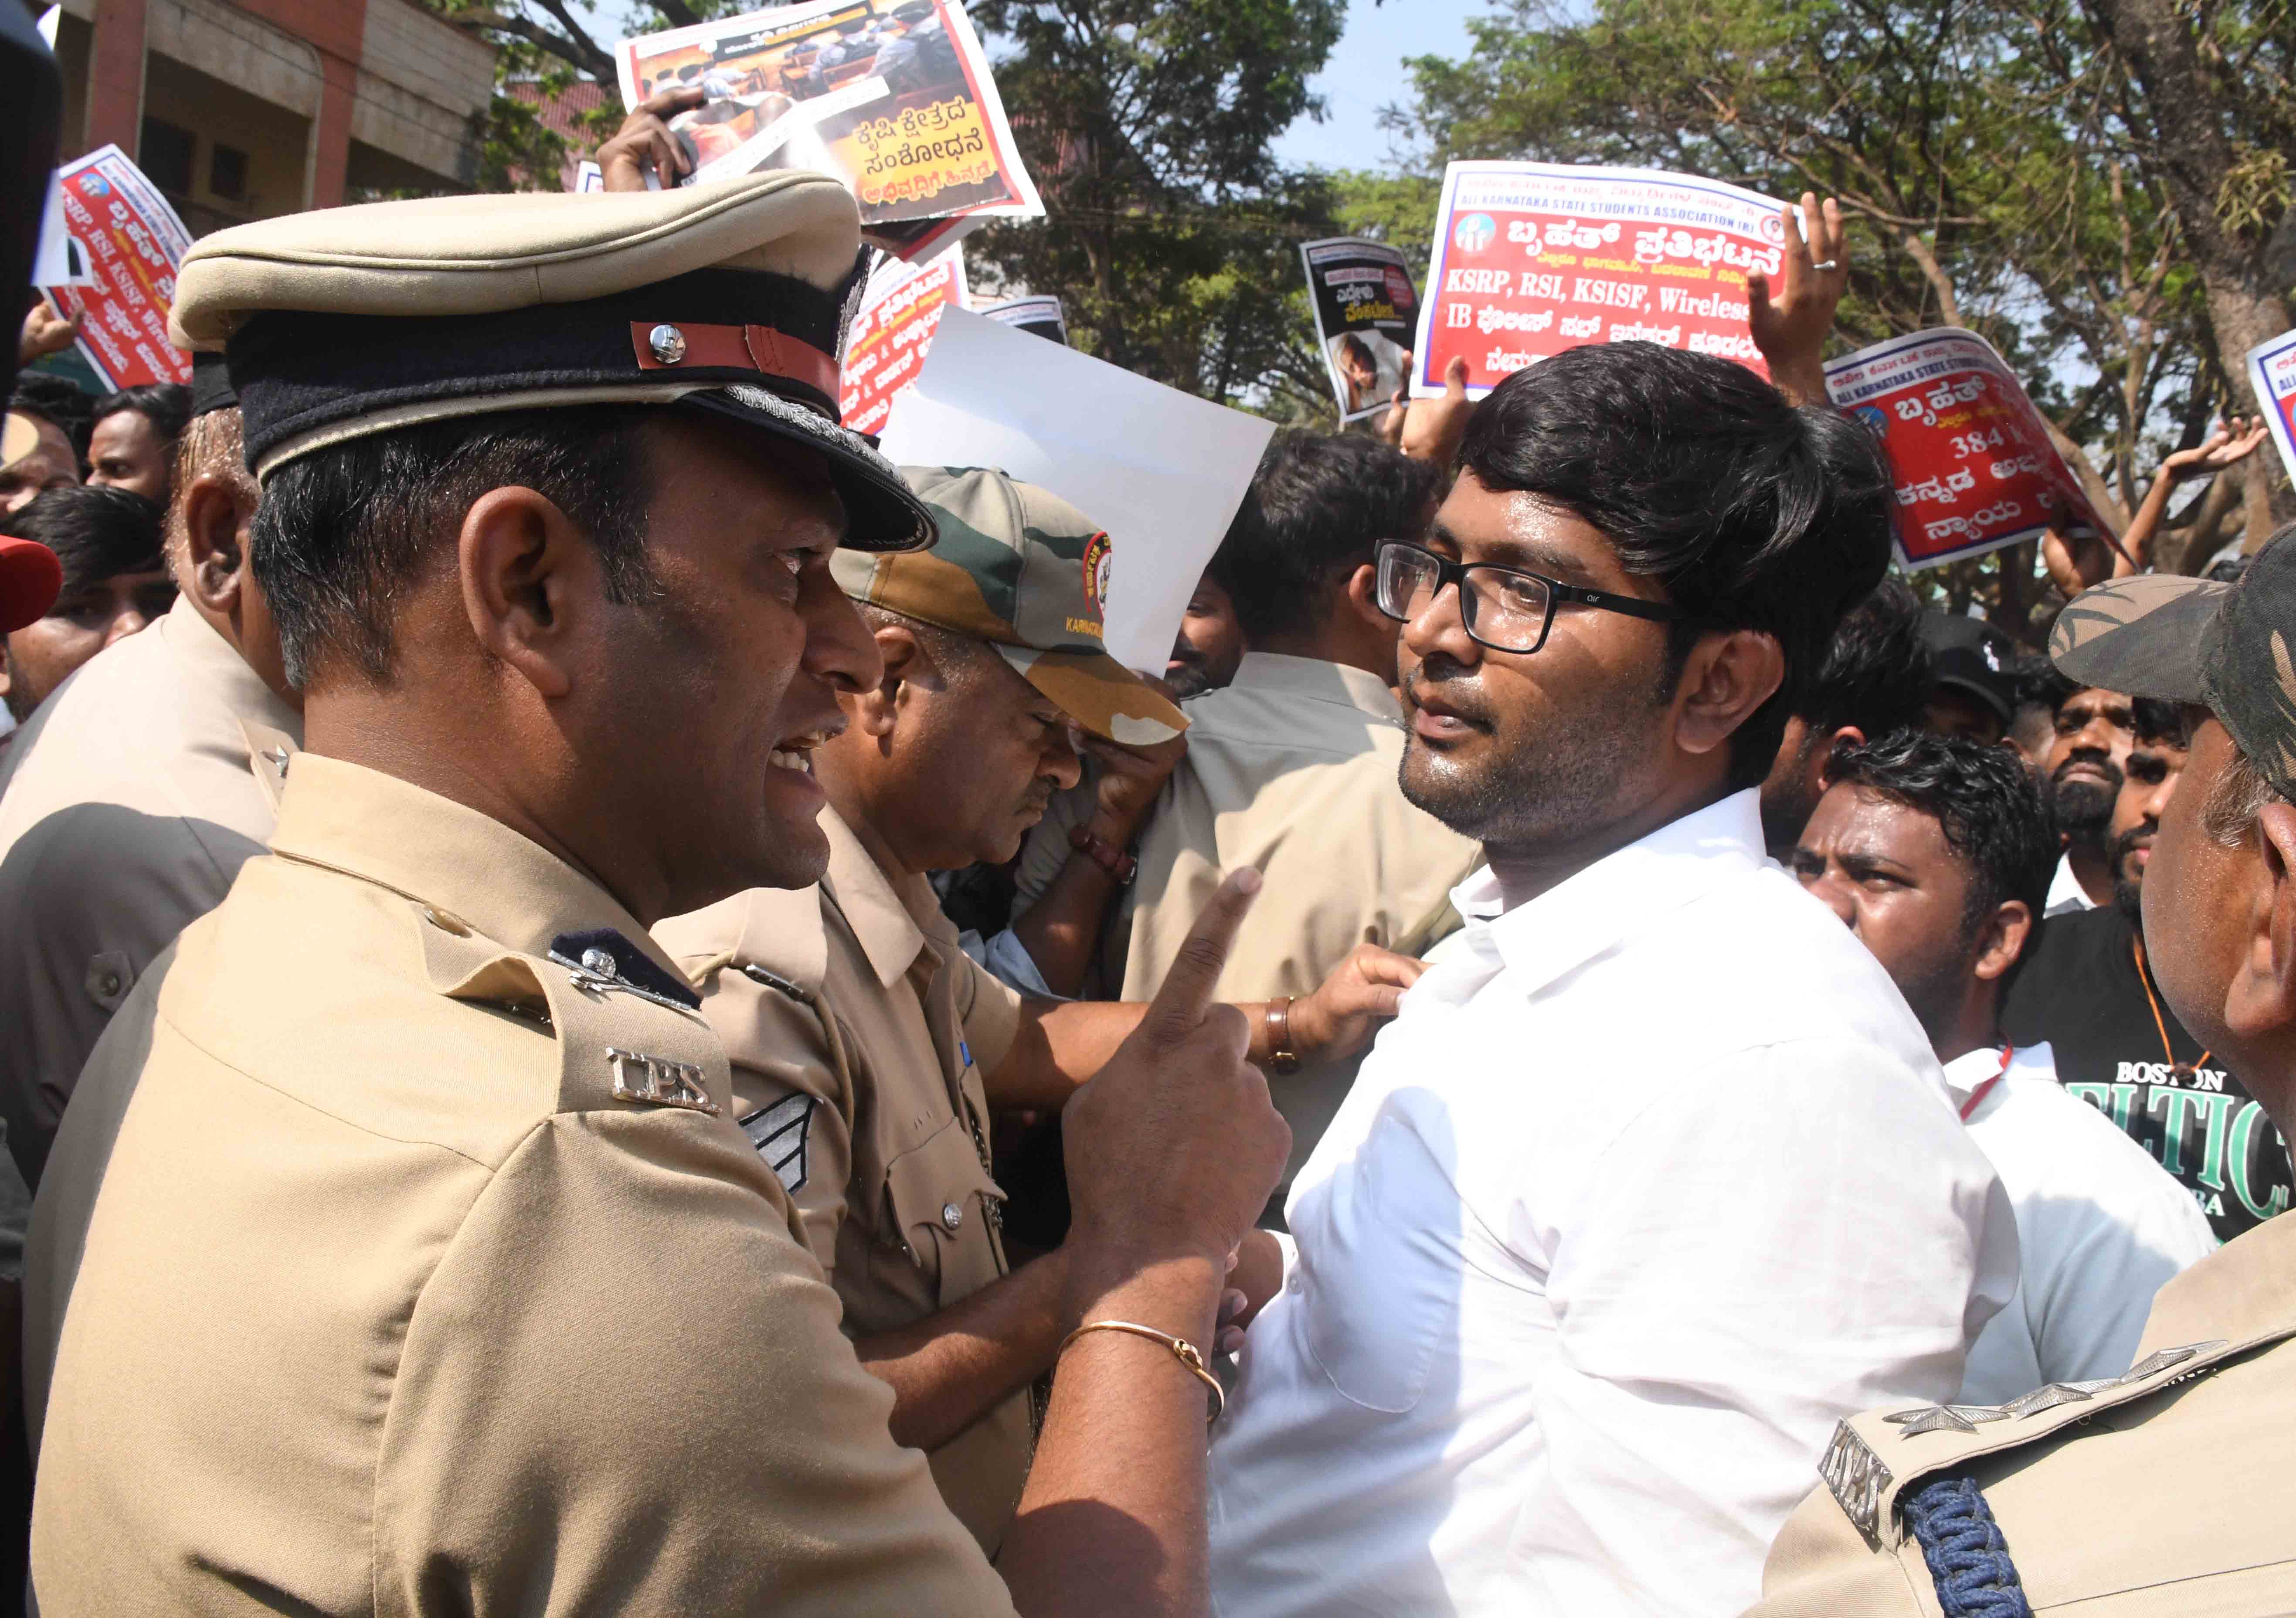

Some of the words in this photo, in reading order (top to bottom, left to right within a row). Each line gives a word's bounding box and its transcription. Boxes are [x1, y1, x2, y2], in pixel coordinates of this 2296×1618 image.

[854, 112, 896, 150] ಕೃಷಿ
[901, 98, 965, 137] ಕ್ಷೇತ್ರದ
[866, 126, 984, 175] ಸಂಶೋಧನೆ
[1481, 196, 1549, 208] KARNATAKA
[1552, 199, 1586, 211] STATE
[1590, 202, 1650, 217] STUDENTS
[1654, 205, 1735, 228] ASSOCIATION
[1507, 219, 1621, 257] ಬೃಹತ್
[1635, 226, 1783, 276] ಪ್ರತಿಭಟನೆ
[88, 227, 115, 266] RSI,
[110, 256, 146, 314] KSISF,
[140, 308, 183, 369] Wireless
[1445, 268, 1514, 299] KSRP,
[1518, 272, 1568, 304] RSI,
[1572, 277, 1653, 315] KSISF,
[1659, 286, 1751, 322] Wireless
[1446, 303, 1472, 329] IB
[1836, 392, 1854, 404] ALL
[1854, 369, 1915, 398] KARNATAKA
[1916, 360, 1946, 380] STATE
[1895, 374, 1987, 427] ಬೃಹತ್
[1950, 426, 2004, 459] 384
[1895, 466, 1975, 506] ಕನ್ನಡ
[1924, 500, 2021, 541] ನ್ಯಾಯ
[1586, 594, 1600, 603] air
[606, 1046, 723, 1117] IPS
